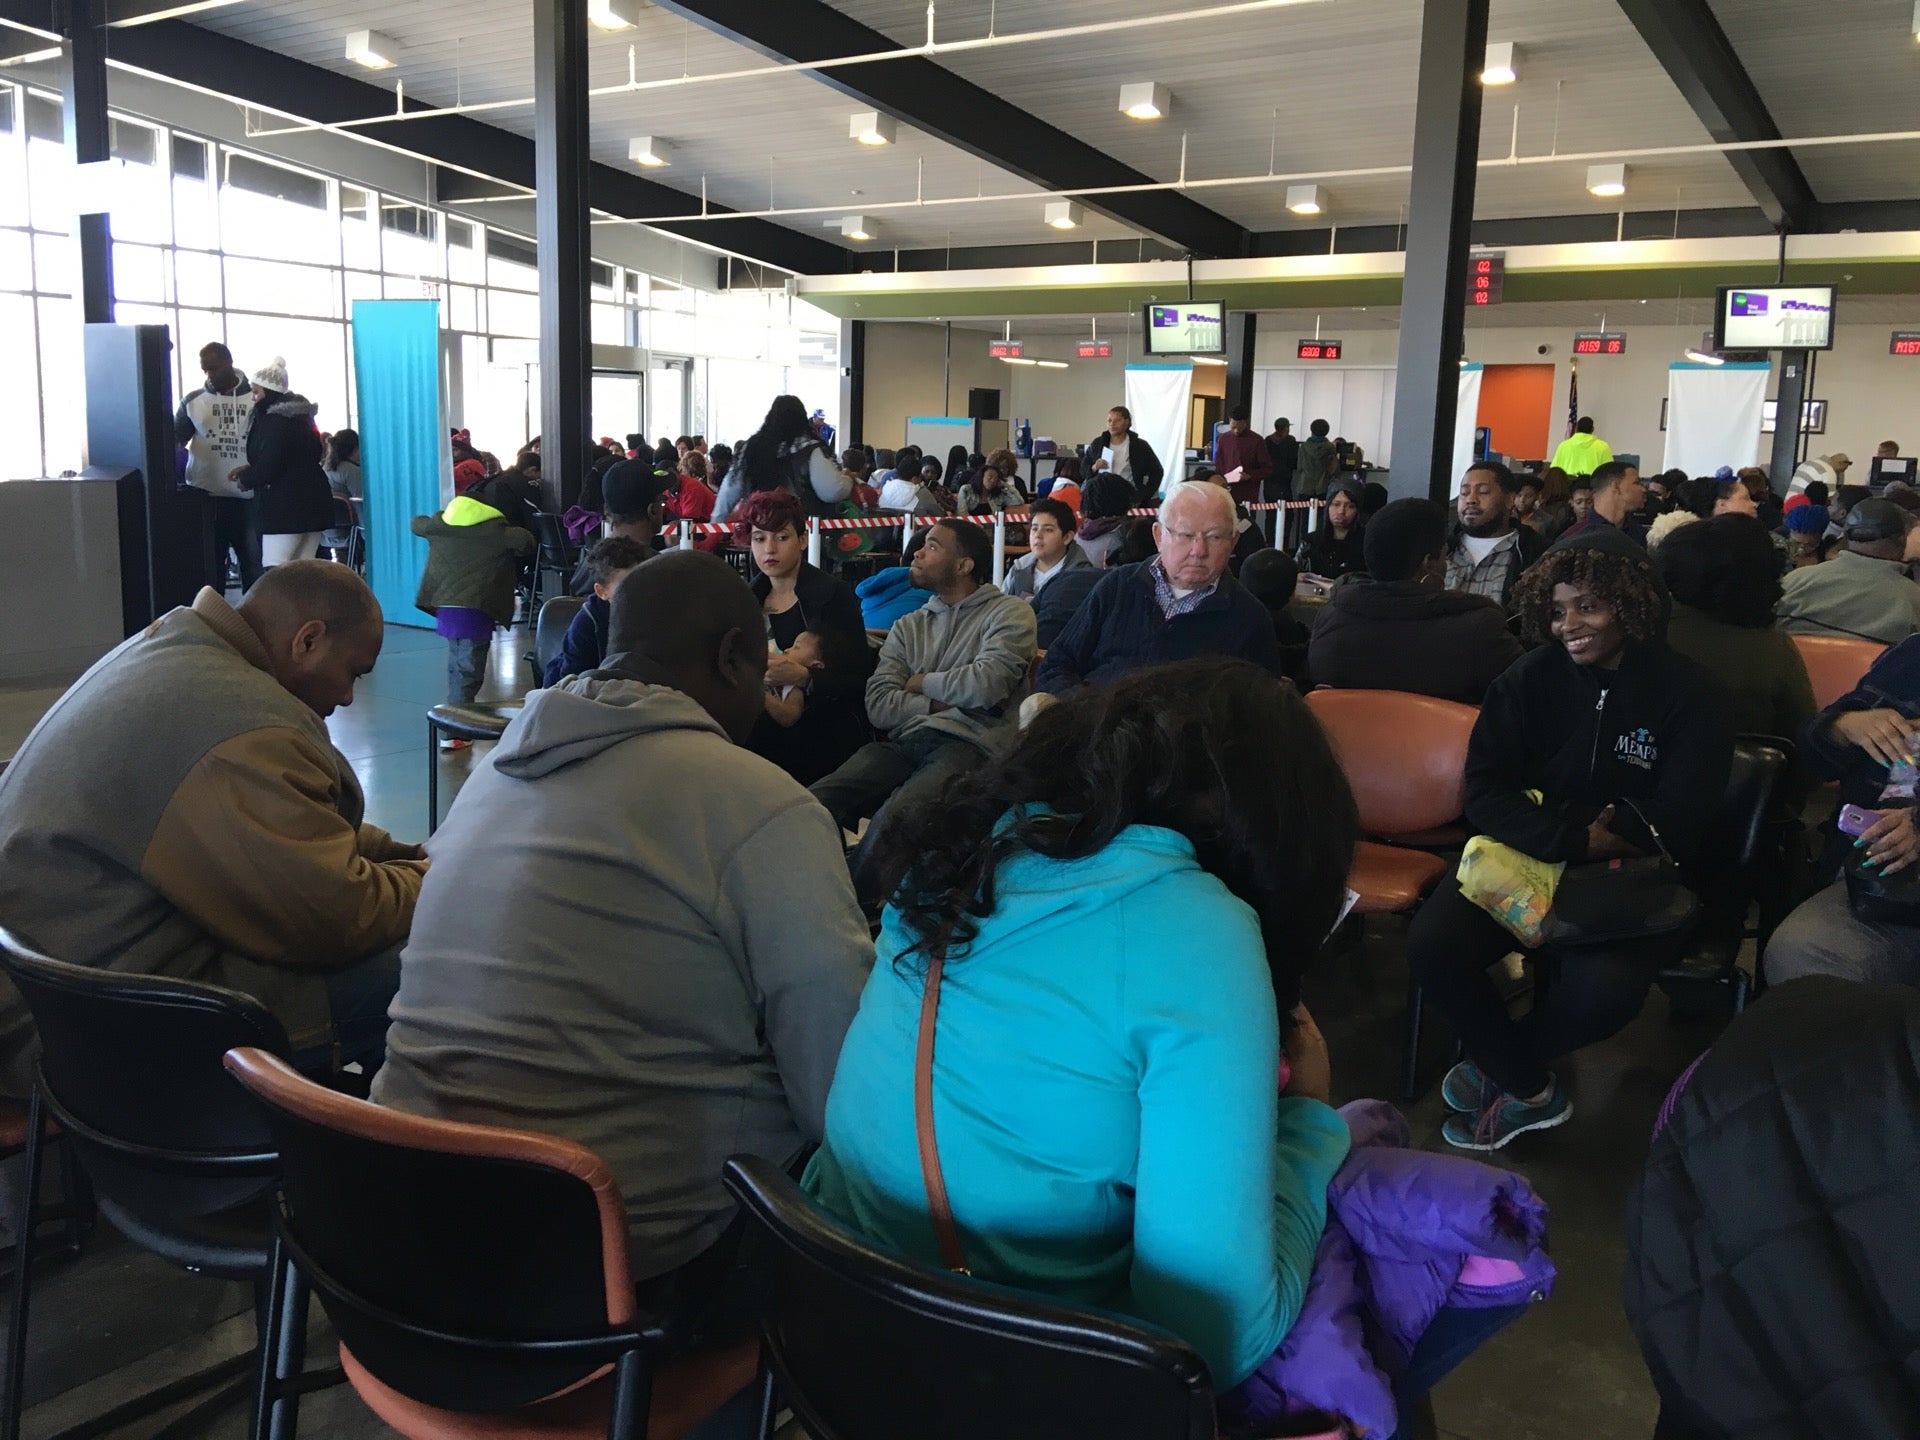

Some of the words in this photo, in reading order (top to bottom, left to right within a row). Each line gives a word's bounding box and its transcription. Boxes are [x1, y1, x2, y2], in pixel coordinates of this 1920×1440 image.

[1477, 260, 1490, 273] 02
[1476, 276, 1489, 288] 06
[1475, 291, 1488, 304] 02
[1577, 340, 1600, 353] A169
[1608, 340, 1621, 353] 06
